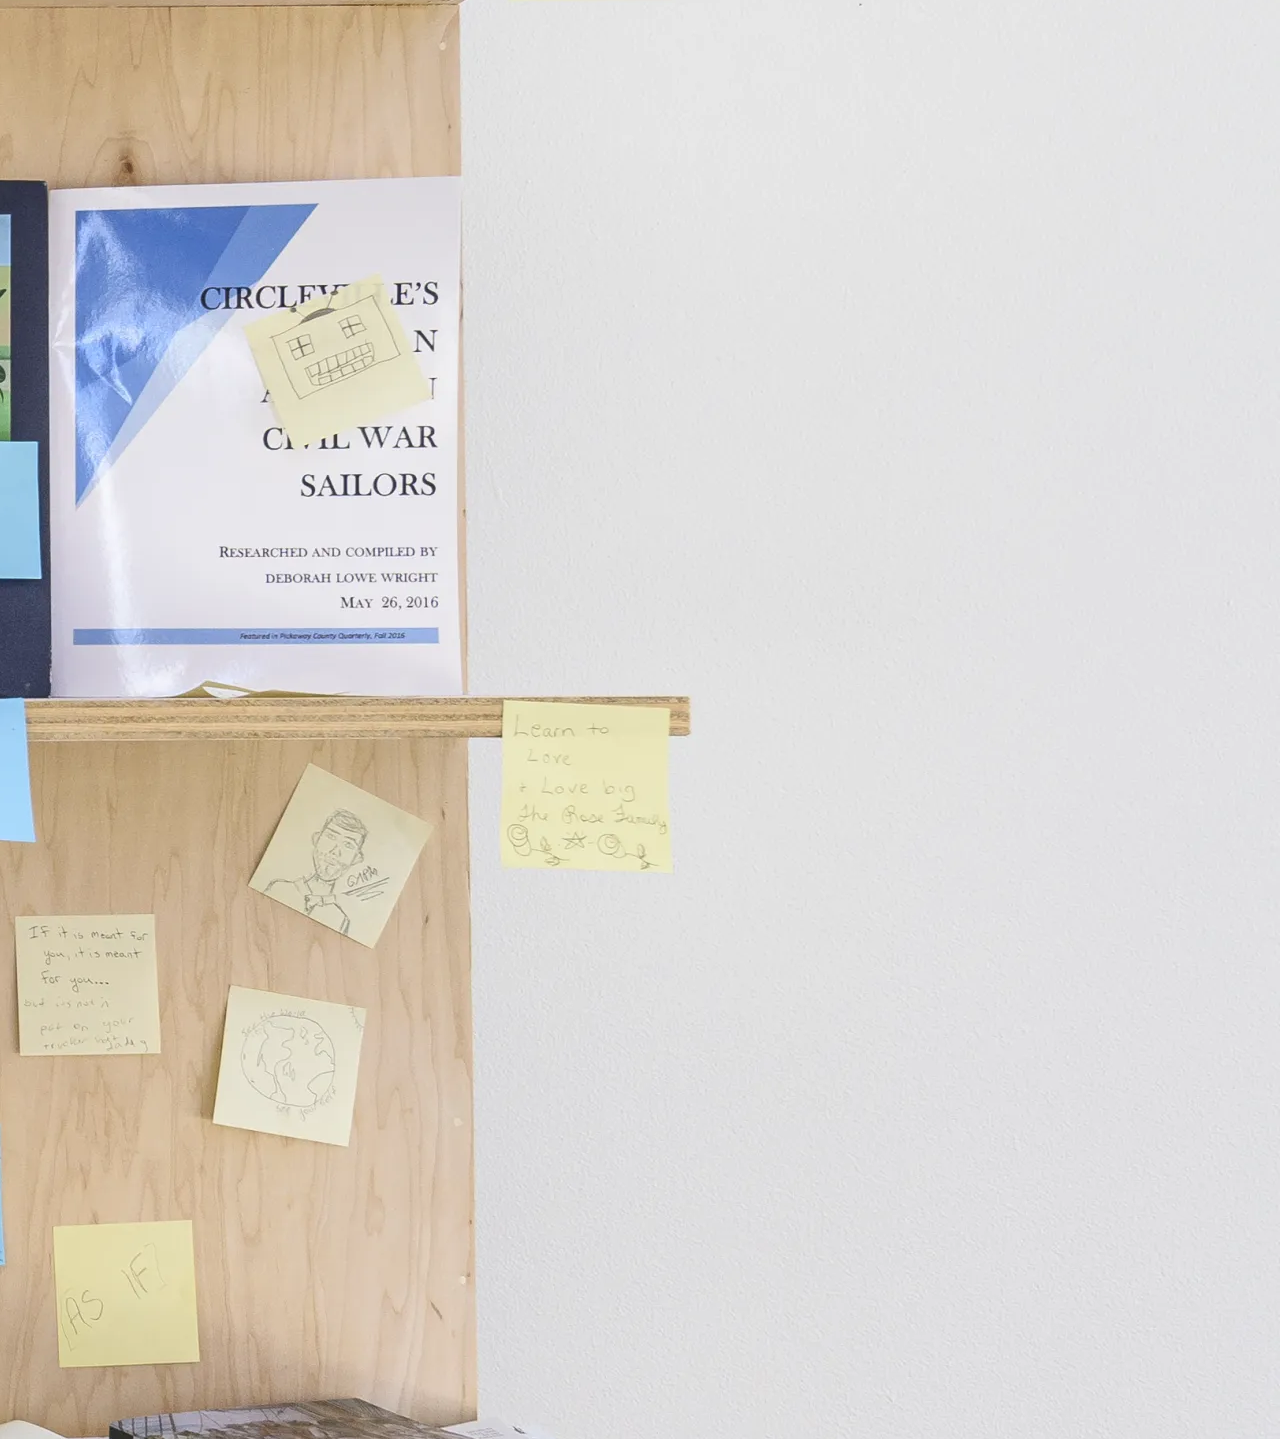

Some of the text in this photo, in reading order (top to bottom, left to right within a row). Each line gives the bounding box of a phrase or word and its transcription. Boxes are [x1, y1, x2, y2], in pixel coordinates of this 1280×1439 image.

[357, 426, 438, 448] WAR
[300, 472, 437, 498] SAILORS
[219, 545, 438, 559] RESEARCHED AND COMPILED BY
[265, 571, 438, 584] DEBORAH LOWE WRIGHT
[240, 631, 406, 641] Featured in Pickaway County Quarterly, Fall 2016
